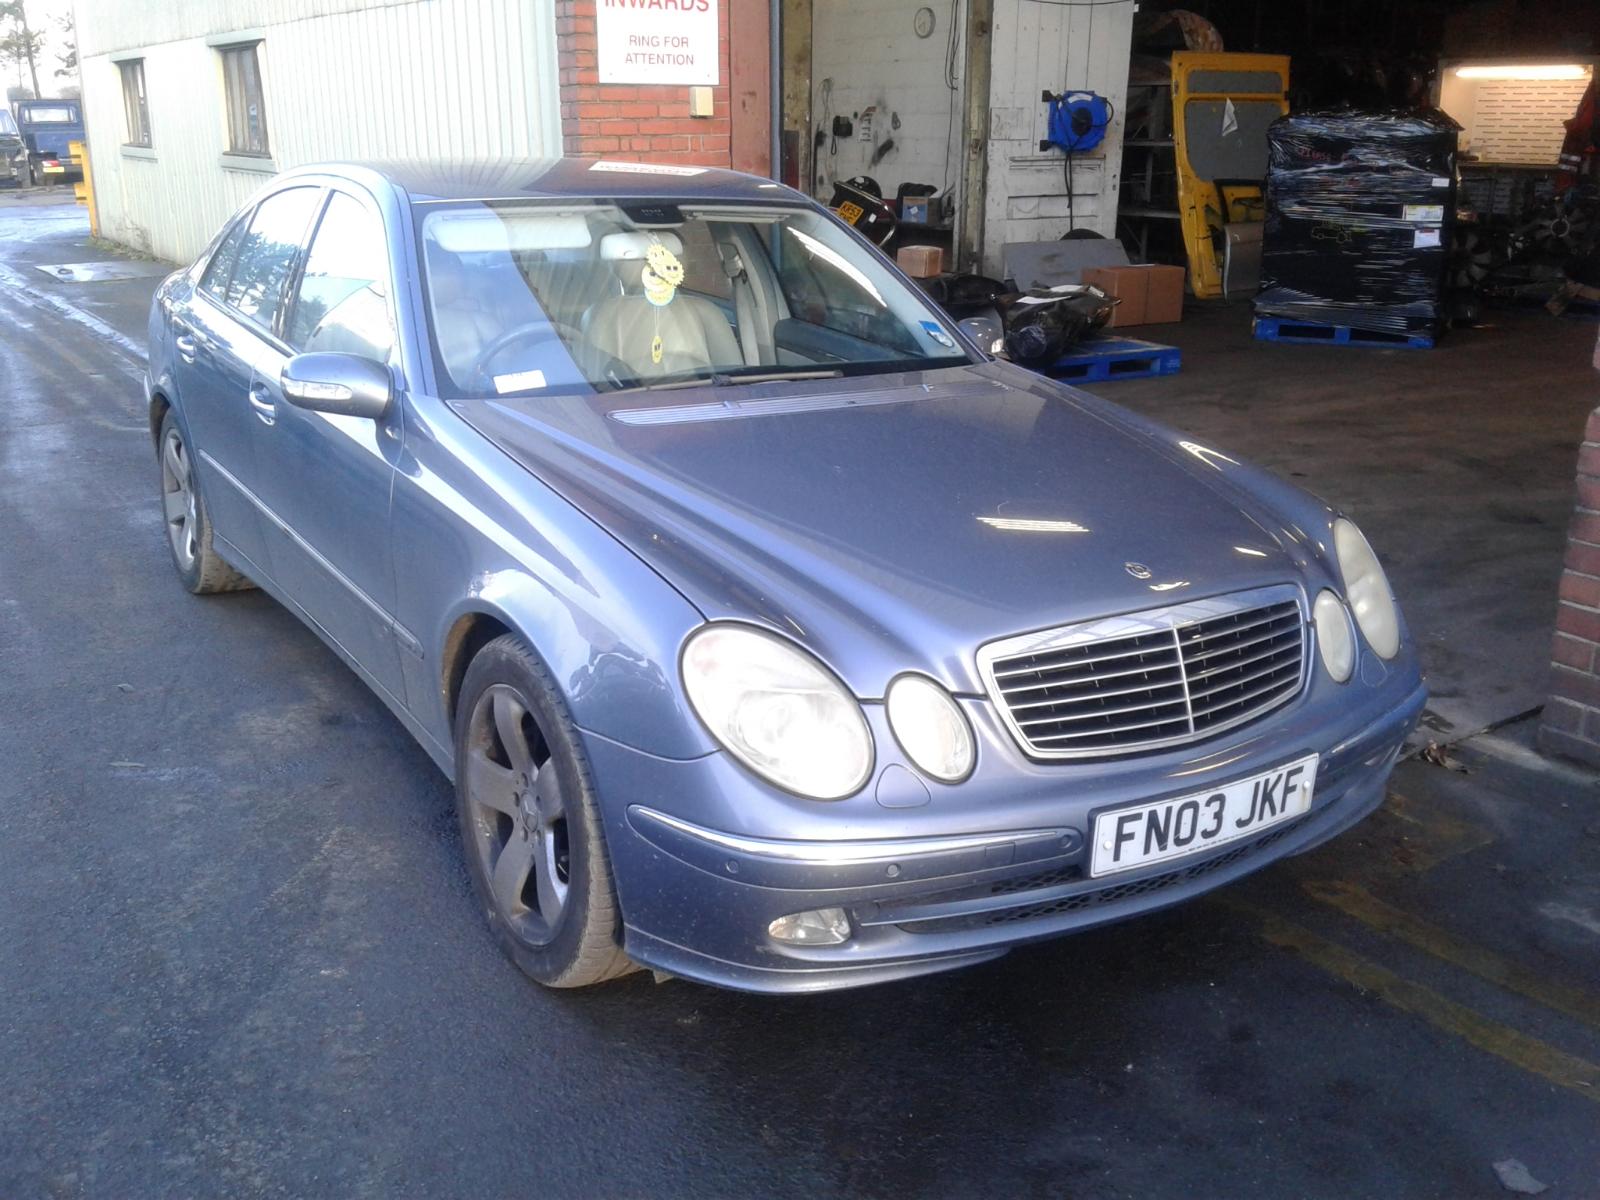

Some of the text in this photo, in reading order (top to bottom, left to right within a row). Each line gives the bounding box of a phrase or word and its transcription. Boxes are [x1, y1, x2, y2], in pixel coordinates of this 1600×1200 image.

[629, 35, 689, 48] RING FOR
[625, 53, 694, 66] ATTENTION
[1113, 766, 1304, 862] FN03 JKF
